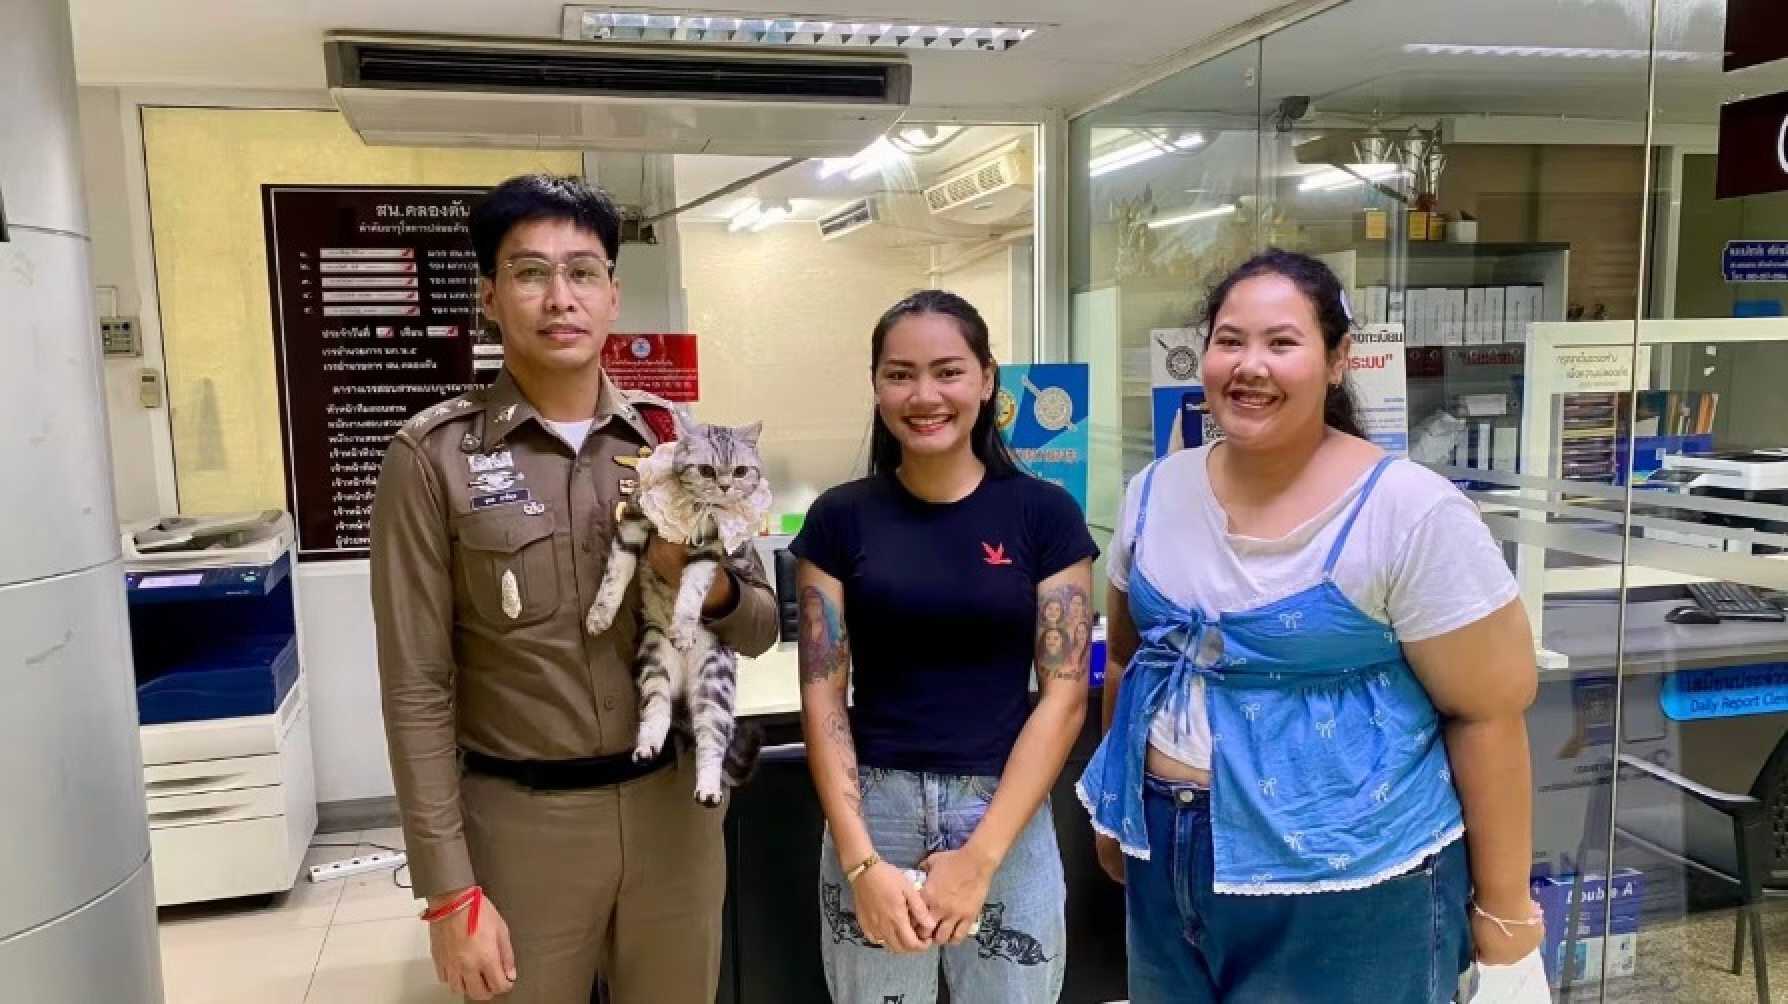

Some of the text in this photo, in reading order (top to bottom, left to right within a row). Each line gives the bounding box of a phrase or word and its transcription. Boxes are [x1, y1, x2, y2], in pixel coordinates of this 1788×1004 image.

[376, 199, 471, 217] สน.คลองตัน
[1690, 698, 1718, 713] Daily
[1722, 695, 1760, 712] Report
